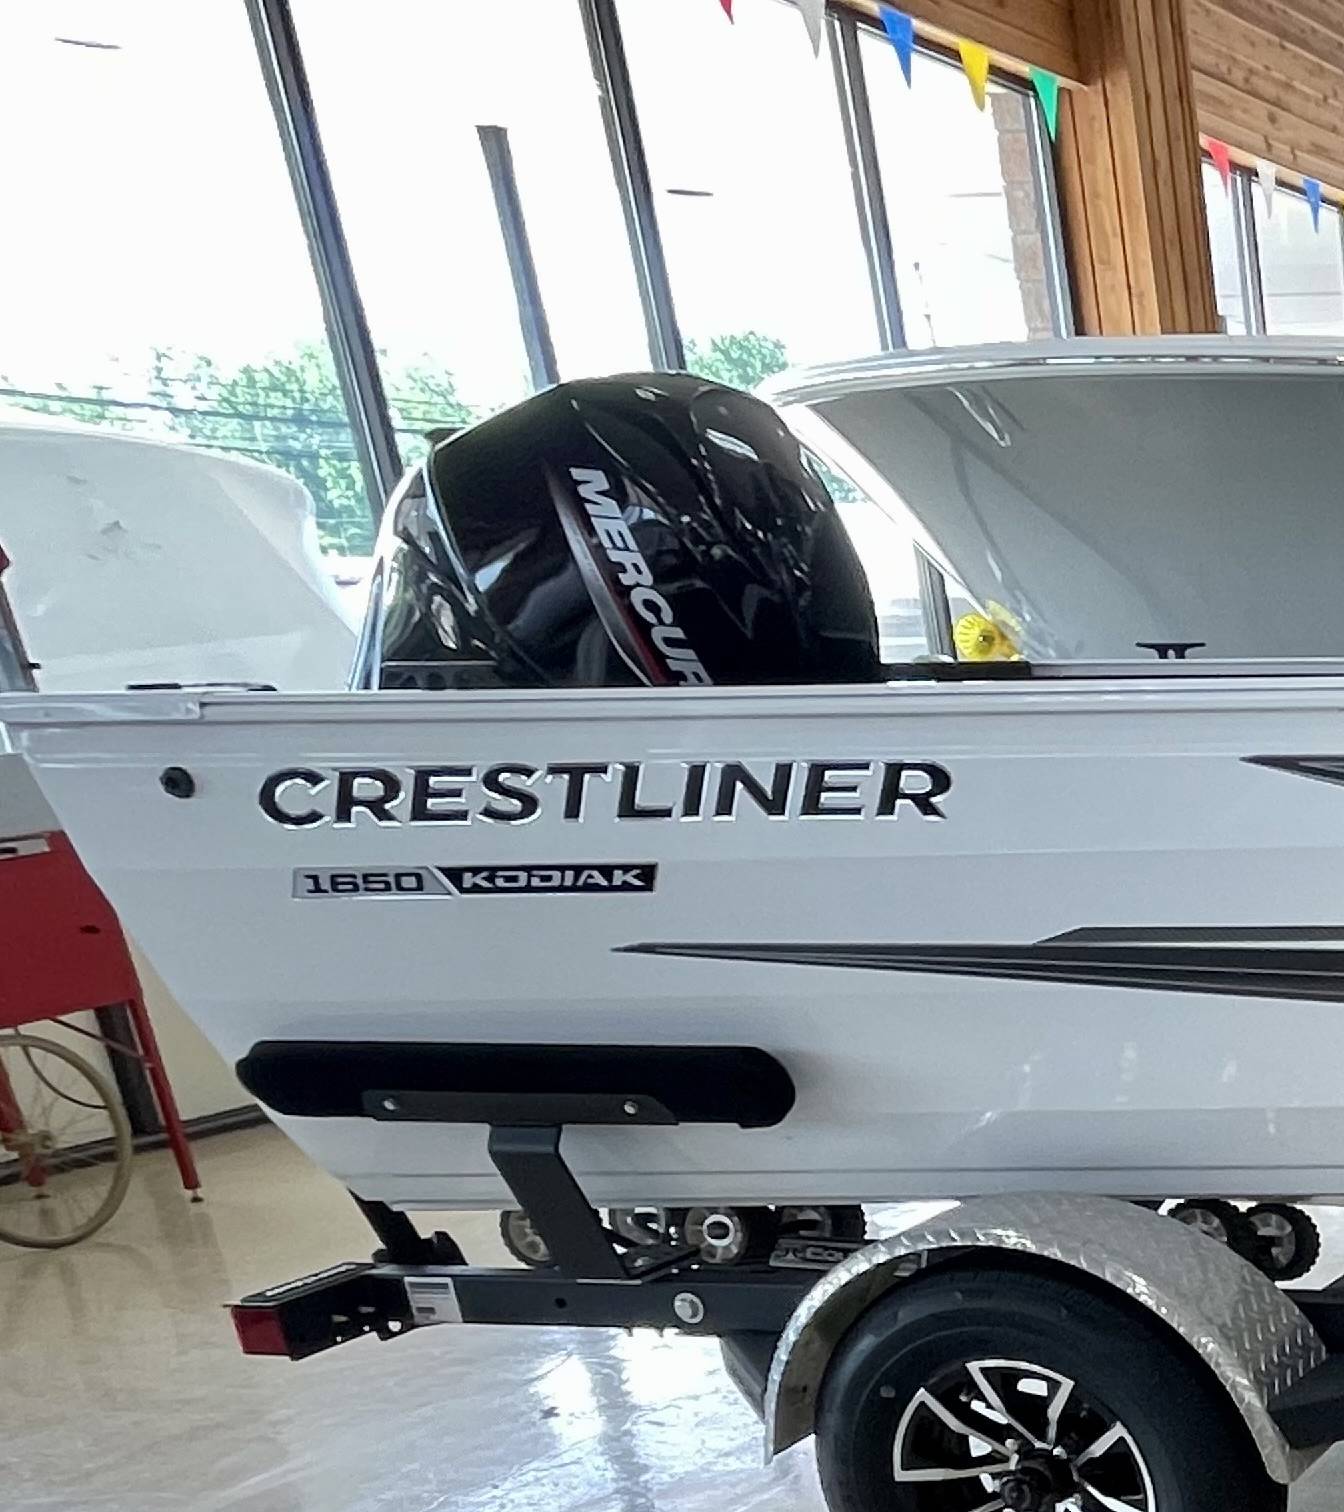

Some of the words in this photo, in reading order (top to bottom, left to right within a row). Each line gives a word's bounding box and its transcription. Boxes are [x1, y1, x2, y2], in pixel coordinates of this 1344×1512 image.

[258, 759, 955, 829] CRESTLINER
[303, 872, 426, 894] 1650
[460, 867, 647, 890] KODIAK
